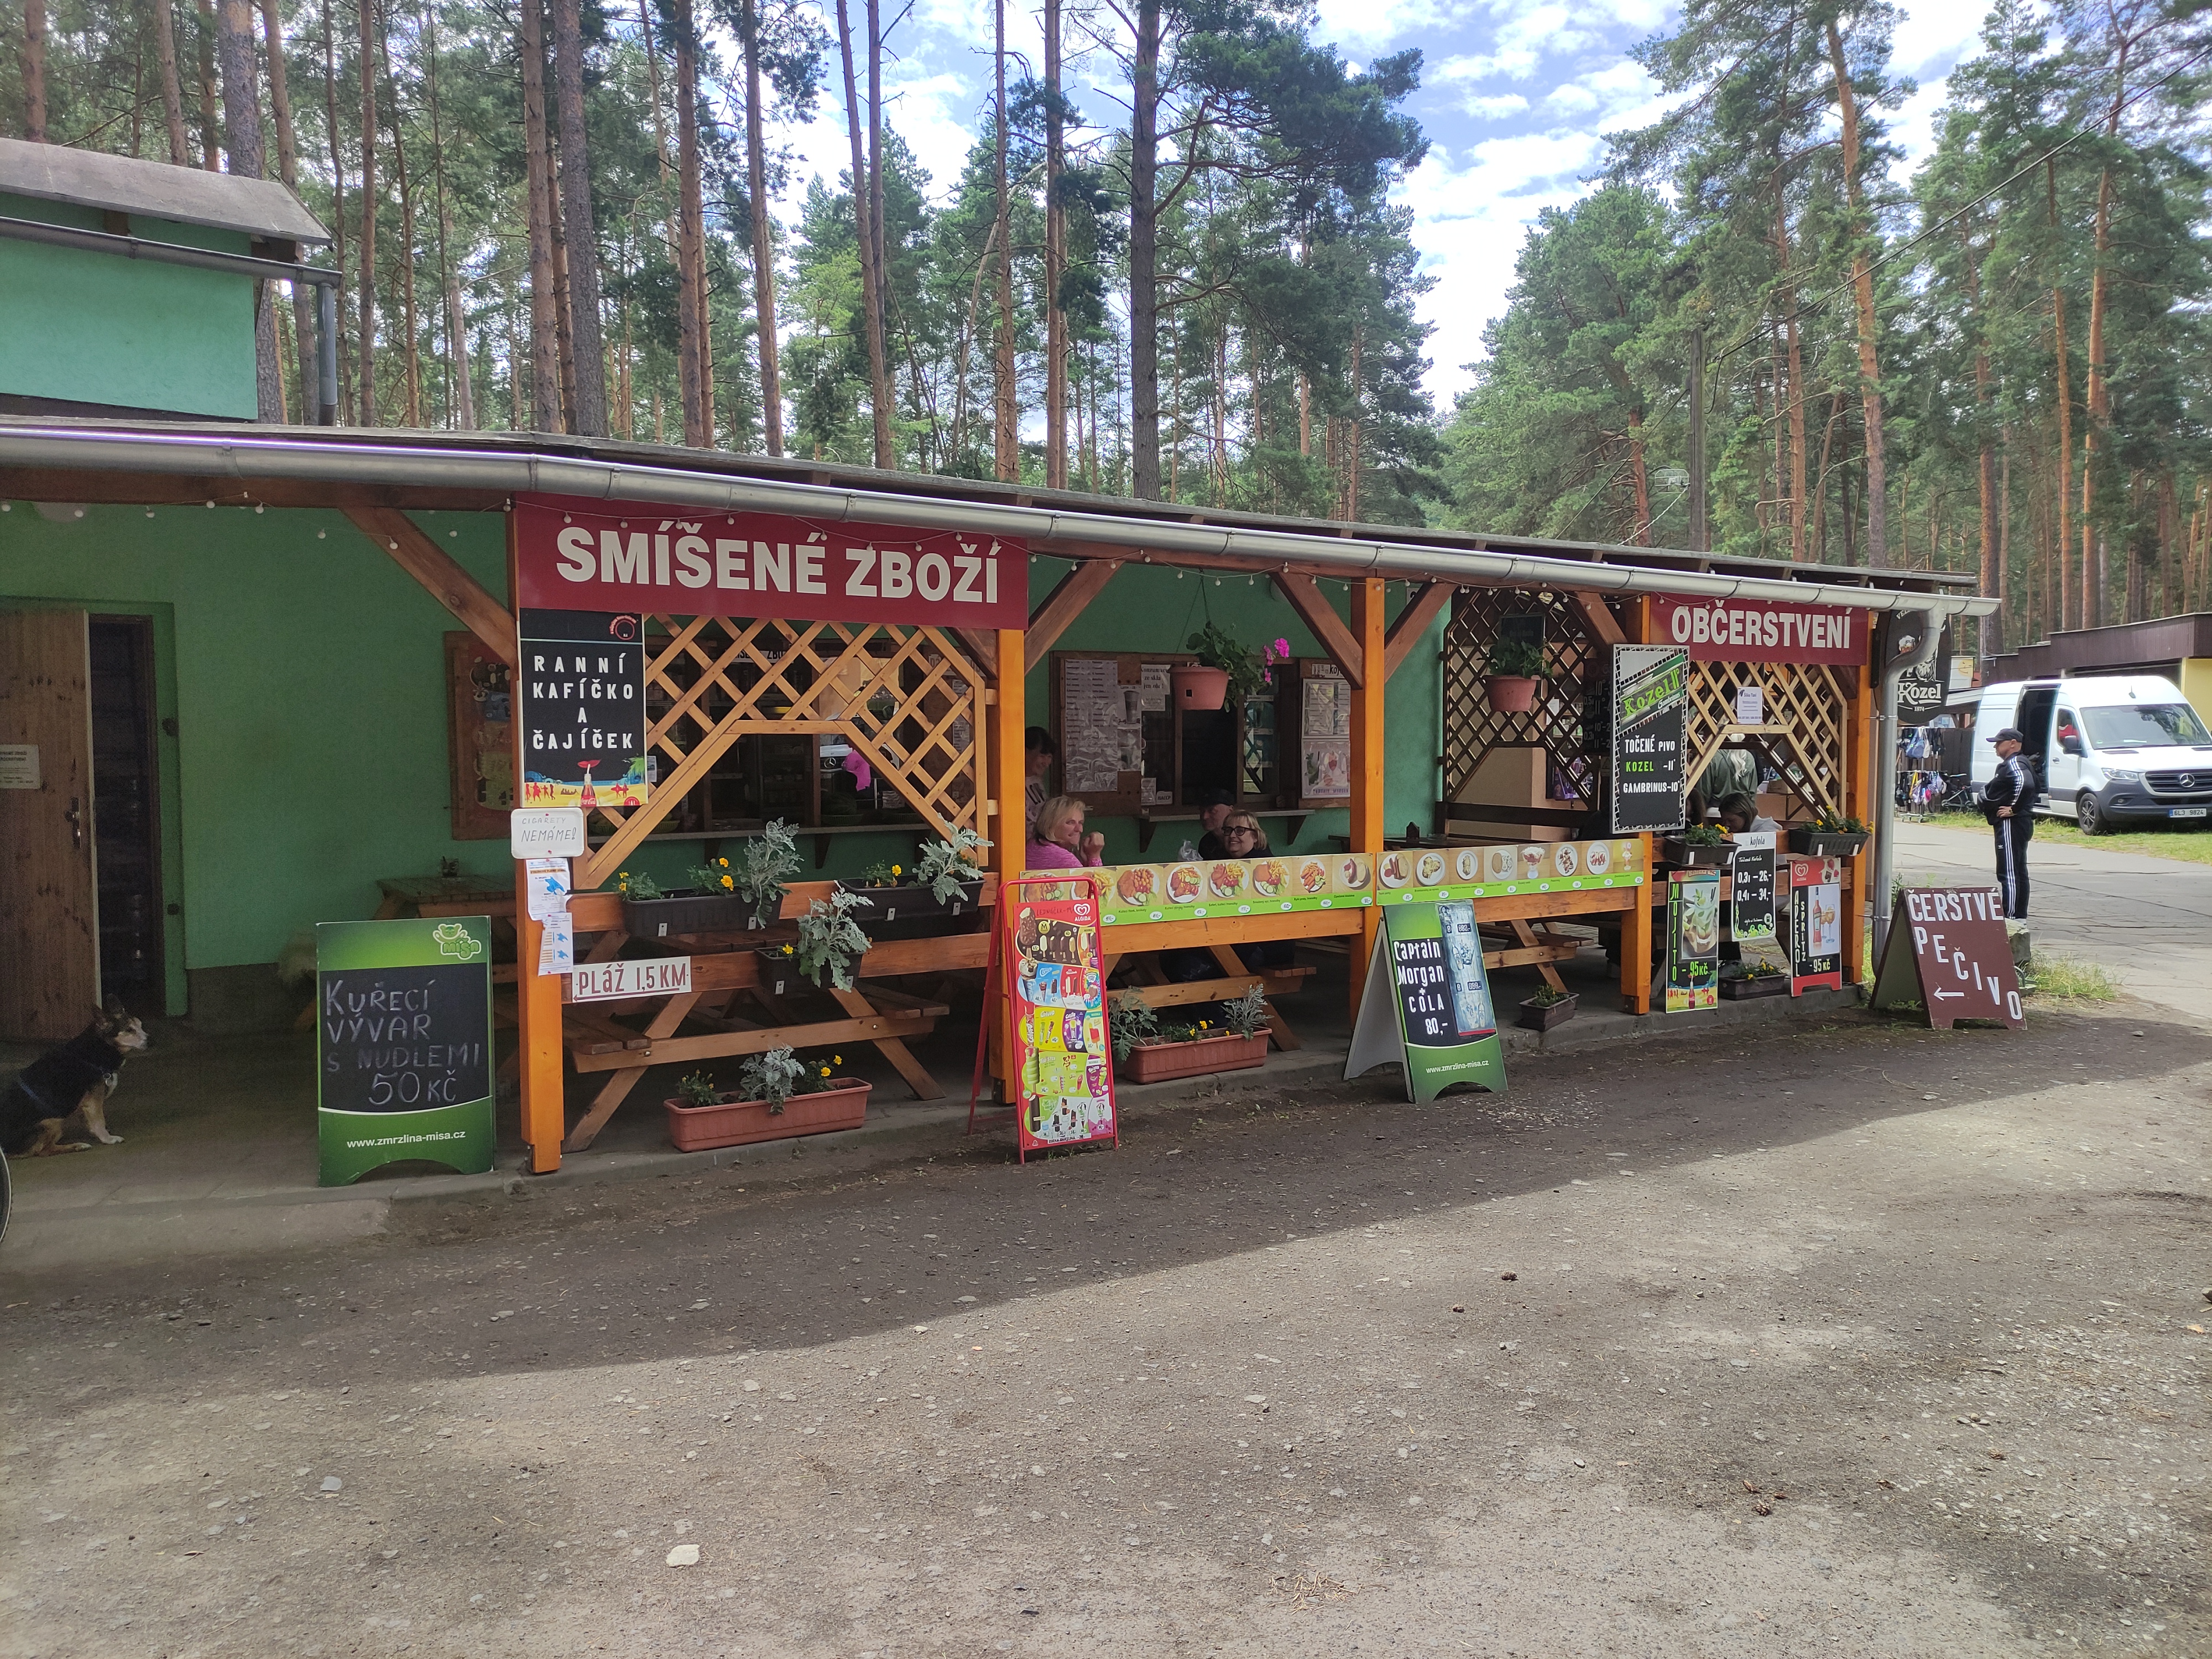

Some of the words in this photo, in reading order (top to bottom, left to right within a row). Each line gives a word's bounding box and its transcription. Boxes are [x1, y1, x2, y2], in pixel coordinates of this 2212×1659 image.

[556, 520, 827, 595] SMÍŠENÉ
[846, 542, 1002, 603] ZBOŽÍ
[1672, 599, 1853, 649] OBČERSTVENÍ
[534, 653, 627, 674] RANNÍ
[533, 677, 633, 699] KAFÍČKO
[1623, 677, 1671, 717] Kozel
[1897, 682, 1942, 705] Kozel
[1658, 692, 1681, 709] Gambrinus
[578, 707, 587, 723] A
[533, 728, 633, 749] ČAJÍČEK
[1625, 734, 1655, 753] TOČENÉ
[1658, 740, 1676, 752] PIVO
[1626, 761, 1654, 772] KOZEL
[521, 826, 576, 842] NEMÁME!
[1750, 836, 1765, 848] kofola
[1908, 888, 2004, 921] ČERSTVÉ
[1670, 884, 1679, 982] MOJITO
[1394, 938, 1441, 962] Captain
[637, 967, 655, 992] 1,5
[660, 963, 686, 988] KM
[1397, 964, 1444, 987] Morgan
[1914, 926, 2022, 1020] PEČIVO
[1408, 993, 1444, 1013] COLA
[327, 1013, 432, 1044] VÝVAR
[1425, 1017, 1448, 1036] 80,-
[358, 1042, 480, 1070] NUDLEMI
[1426, 1060, 1489, 1073] www.zmrzlina-misa.cz
[368, 1071, 420, 1105] 50
[428, 1070, 457, 1103] KČ
[347, 1131, 466, 1148] www.zmrzlina-misa.cz
